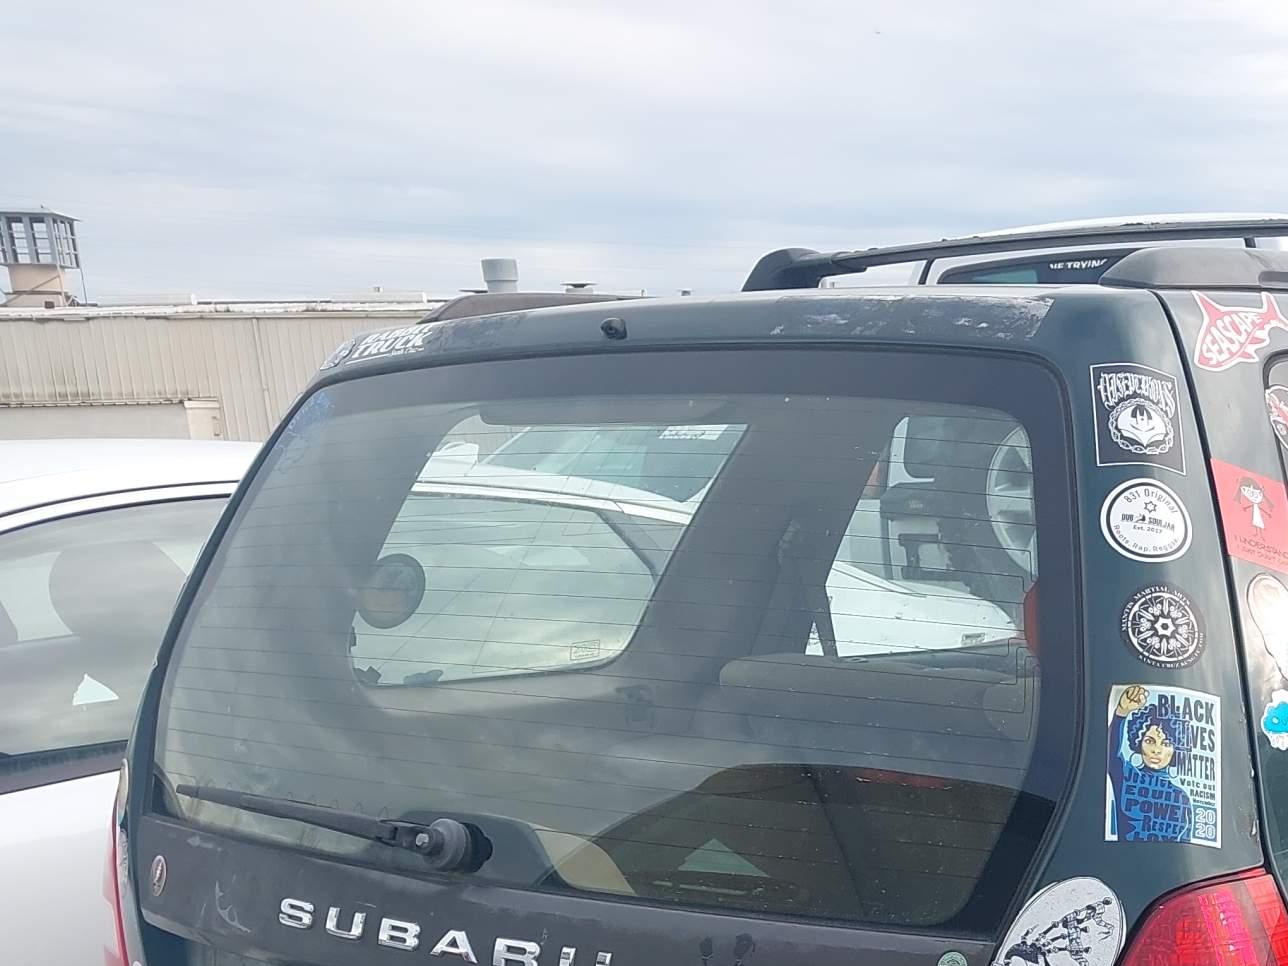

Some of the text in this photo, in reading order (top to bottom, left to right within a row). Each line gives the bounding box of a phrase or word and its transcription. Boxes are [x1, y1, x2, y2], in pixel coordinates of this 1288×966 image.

[351, 331, 433, 359] TRUCK
[1202, 311, 1263, 364] SEASCAPE
[1123, 488, 1179, 514] 831 Original
[1133, 586, 1168, 600] MARTIAL
[1157, 694, 1215, 727] BLACK
[1175, 720, 1216, 753] LIVES
[1177, 751, 1216, 782] MATTER
[1189, 788, 1216, 801] RACISM
[1195, 808, 1216, 825] 20
[1195, 824, 1216, 839] 20
